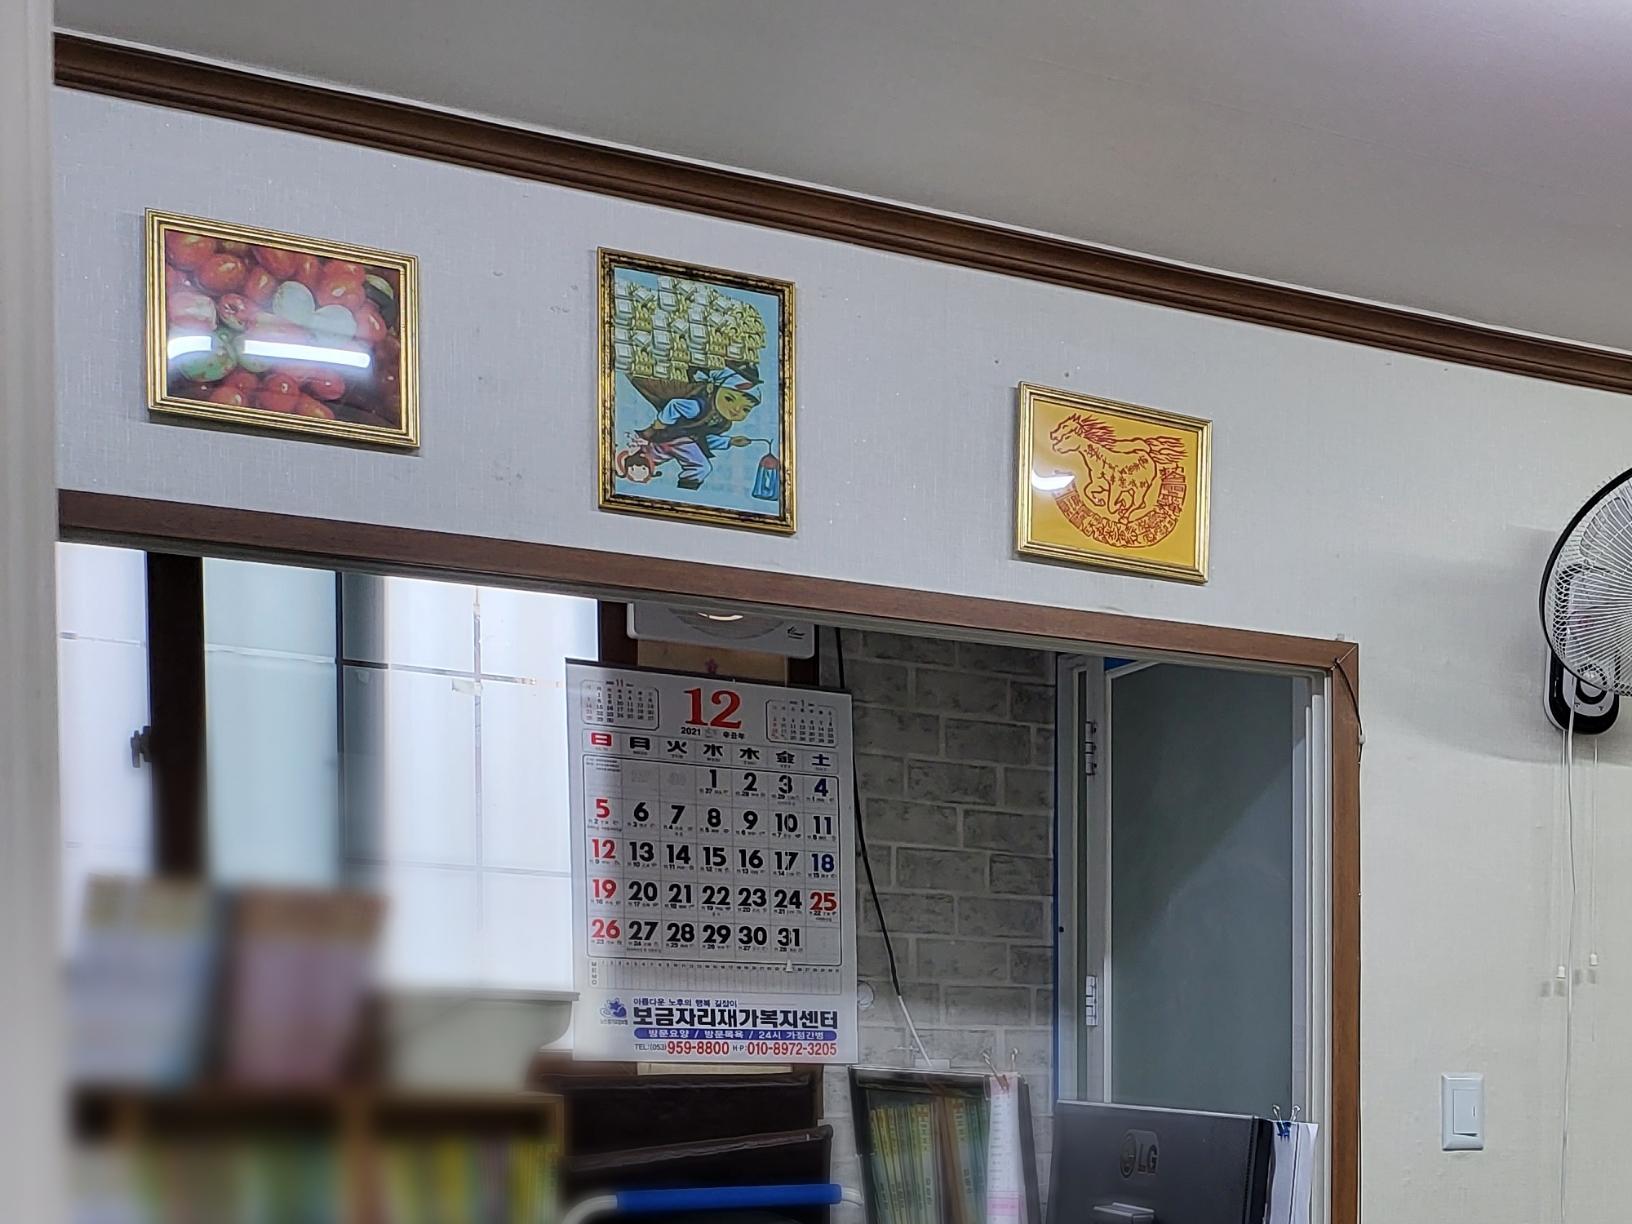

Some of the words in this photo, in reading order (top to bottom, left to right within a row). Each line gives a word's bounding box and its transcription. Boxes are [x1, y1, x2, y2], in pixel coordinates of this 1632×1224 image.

[683, 688, 742, 729] 12
[681, 726, 700, 736] 2021
[591, 733, 612, 747] 日
[630, 736, 650, 751] 月
[667, 740, 687, 754] 火
[703, 744, 723, 757] 水
[740, 747, 760, 760] 木
[776, 751, 795, 764] 金
[812, 754, 831, 767] 土
[709, 769, 717, 788] 1
[743, 772, 758, 792] 2
[778, 775, 793, 794] 3
[814, 778, 829, 797] 4
[596, 799, 610, 818] 5
[633, 802, 649, 822] 6
[671, 805, 686, 824] 7
[707, 808, 721, 828] 8
[743, 810, 758, 830] 9
[775, 813, 798, 833] 10
[813, 816, 831, 835] 11
[592, 839, 616, 859] 12
[629, 841, 654, 862] 13
[666, 844, 691, 864] 14
[703, 846, 727, 867] 15
[739, 849, 763, 869] 16
[775, 851, 799, 871] 17
[812, 853, 835, 873] 18
[592, 879, 617, 899] 19
[628, 881, 658, 902] 20
[668, 883, 692, 904] 21
[702, 885, 731, 906] 22
[738, 887, 767, 907] 23
[774, 889, 802, 909] 24
[810, 892, 837, 912] 25
[592, 919, 620, 939] 26
[628, 921, 659, 940] 27
[666, 922, 695, 943] 28
[702, 924, 731, 944] 29
[738, 926, 767, 946] 30
[777, 928, 800, 947] 31
[634, 997, 666, 1006] 아름다운
[633, 1007, 838, 1029] 보금자리재가복지센터
[667, 1040, 729, 1055] 959-8800
[747, 1041, 837, 1056] 010-8972-3205
[758, 1031, 781, 1039] 24시
